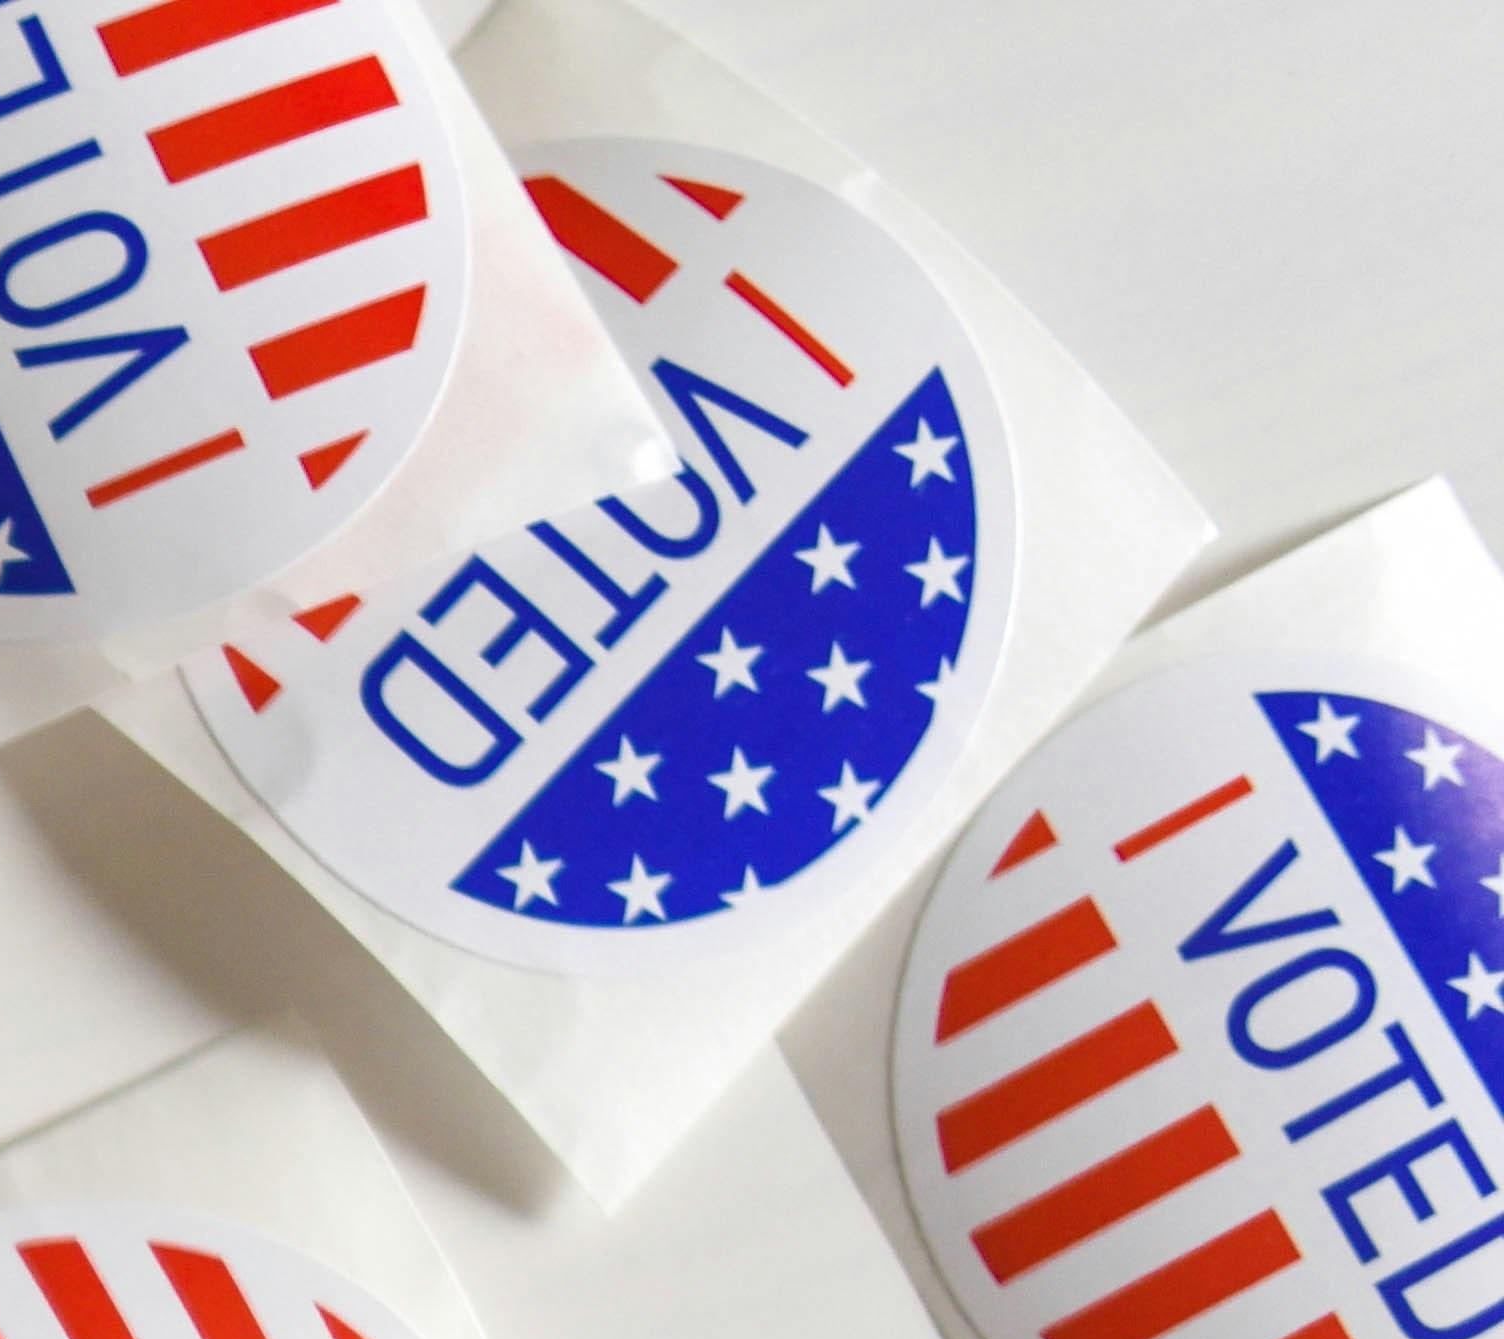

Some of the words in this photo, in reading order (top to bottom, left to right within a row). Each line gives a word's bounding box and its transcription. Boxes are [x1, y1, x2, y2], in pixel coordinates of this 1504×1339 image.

[726, 272, 854, 388] I
[88, 429, 244, 507] I
[1115, 776, 1253, 861] I
